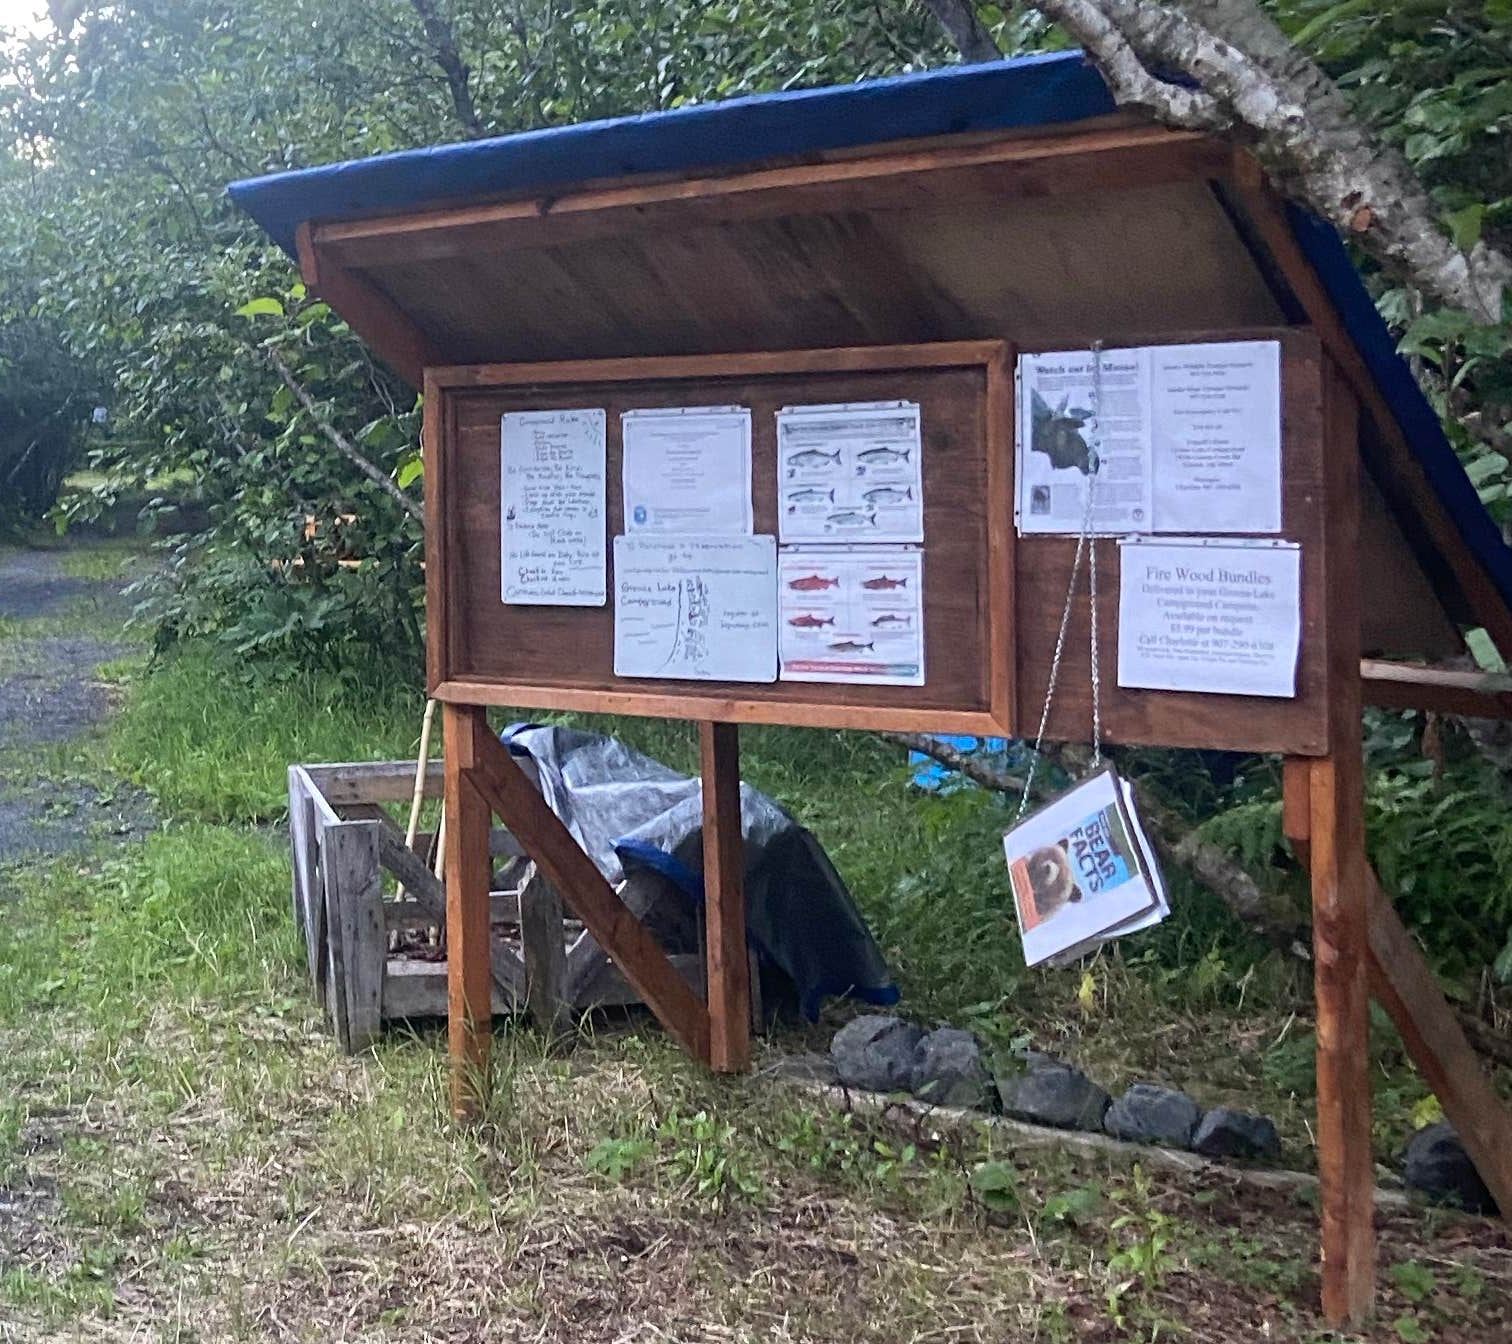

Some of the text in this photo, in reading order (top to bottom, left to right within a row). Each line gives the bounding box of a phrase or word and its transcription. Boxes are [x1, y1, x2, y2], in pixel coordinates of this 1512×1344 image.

[1036, 365, 1065, 374] Watch
[1068, 365, 1084, 374] out
[1146, 566, 1272, 586] Fire Wood Bundles
[1139, 634, 1158, 646] Call
[1069, 826, 1104, 893] FACTS
[1085, 821, 1116, 879] BEAR
